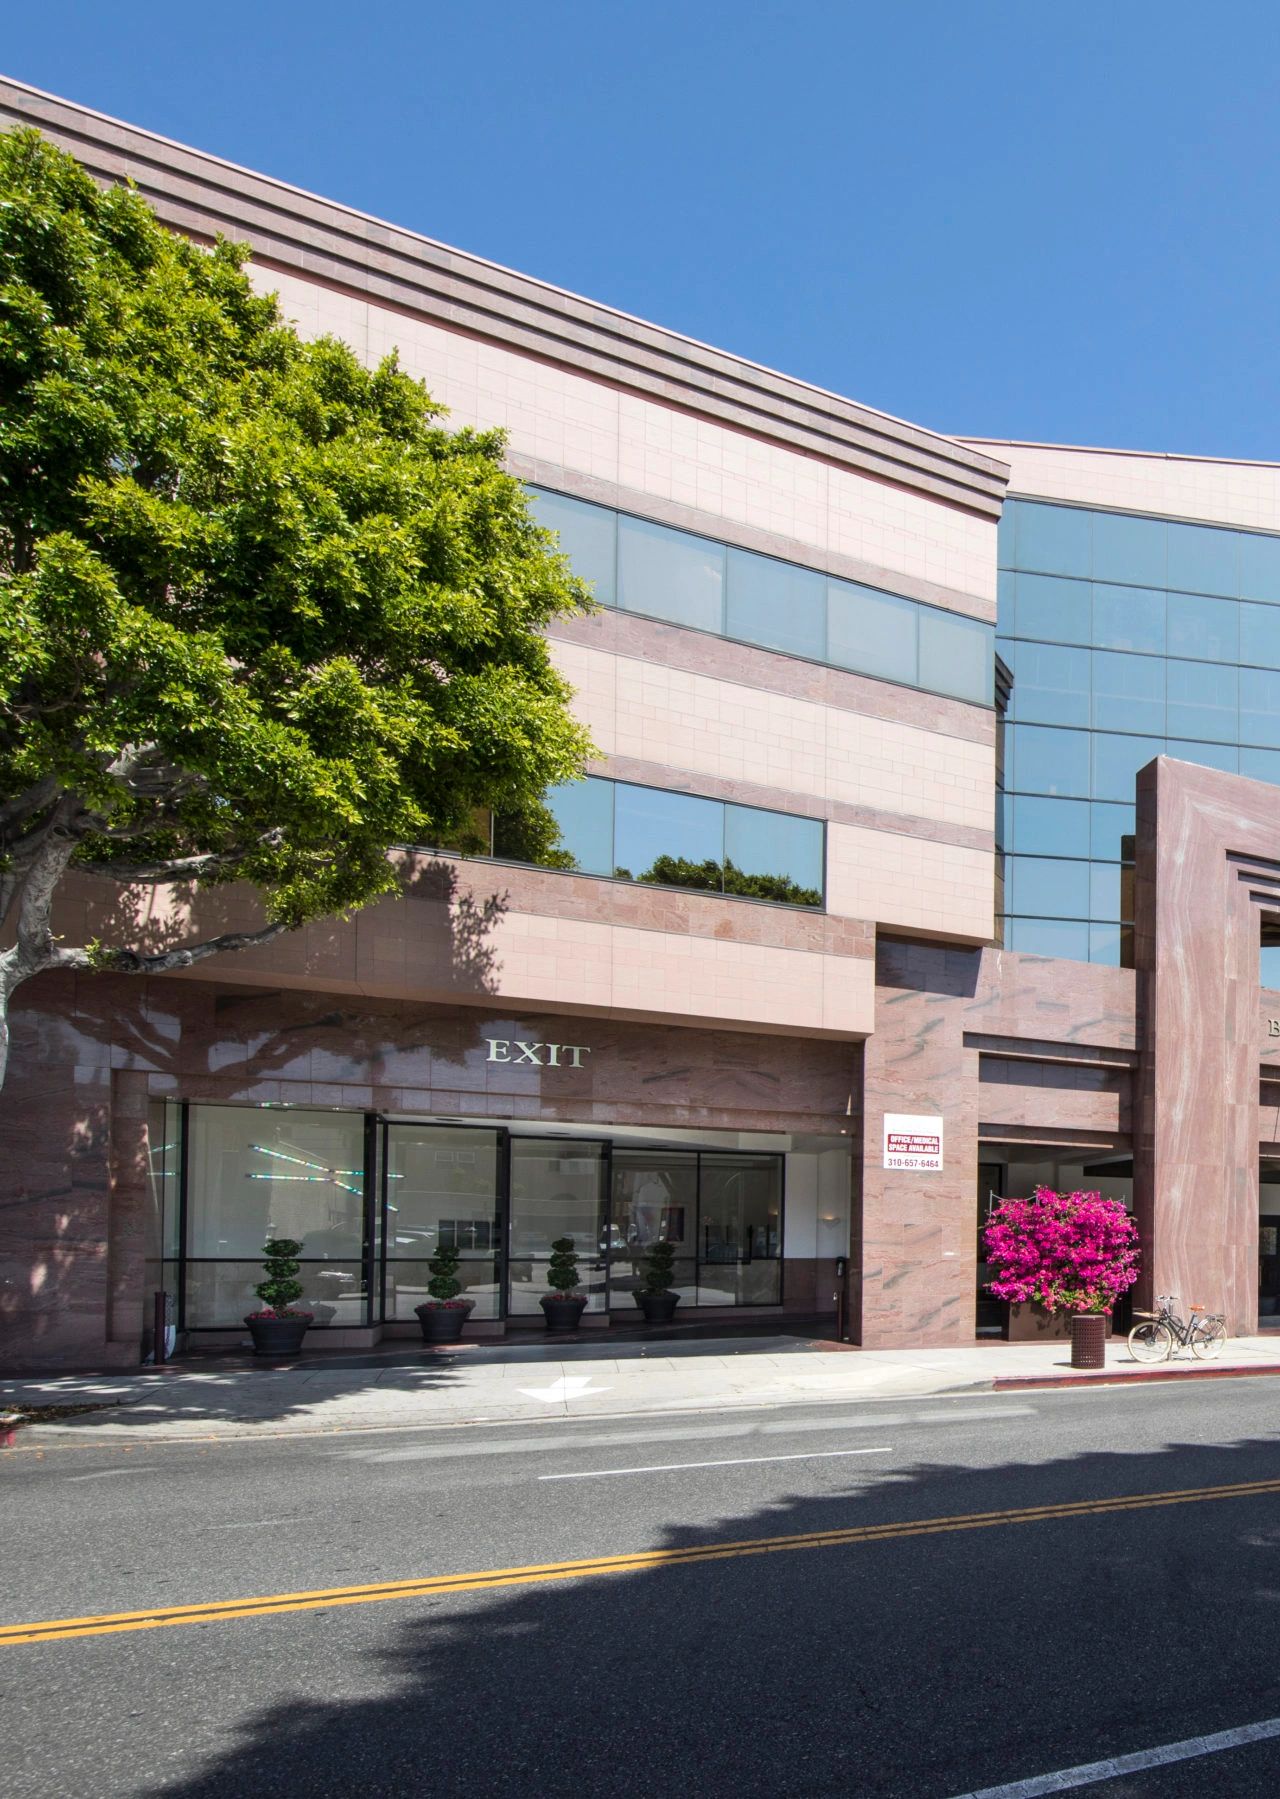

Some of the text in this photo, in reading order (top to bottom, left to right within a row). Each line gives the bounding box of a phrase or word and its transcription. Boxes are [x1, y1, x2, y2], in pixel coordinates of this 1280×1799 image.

[485, 1038, 591, 1068] EXIT
[891, 1135, 938, 1144] OFFICE/MEDICAL
[908, 1145, 938, 1153] AVAILABLE
[888, 1158, 939, 1168] 310-657-6464
